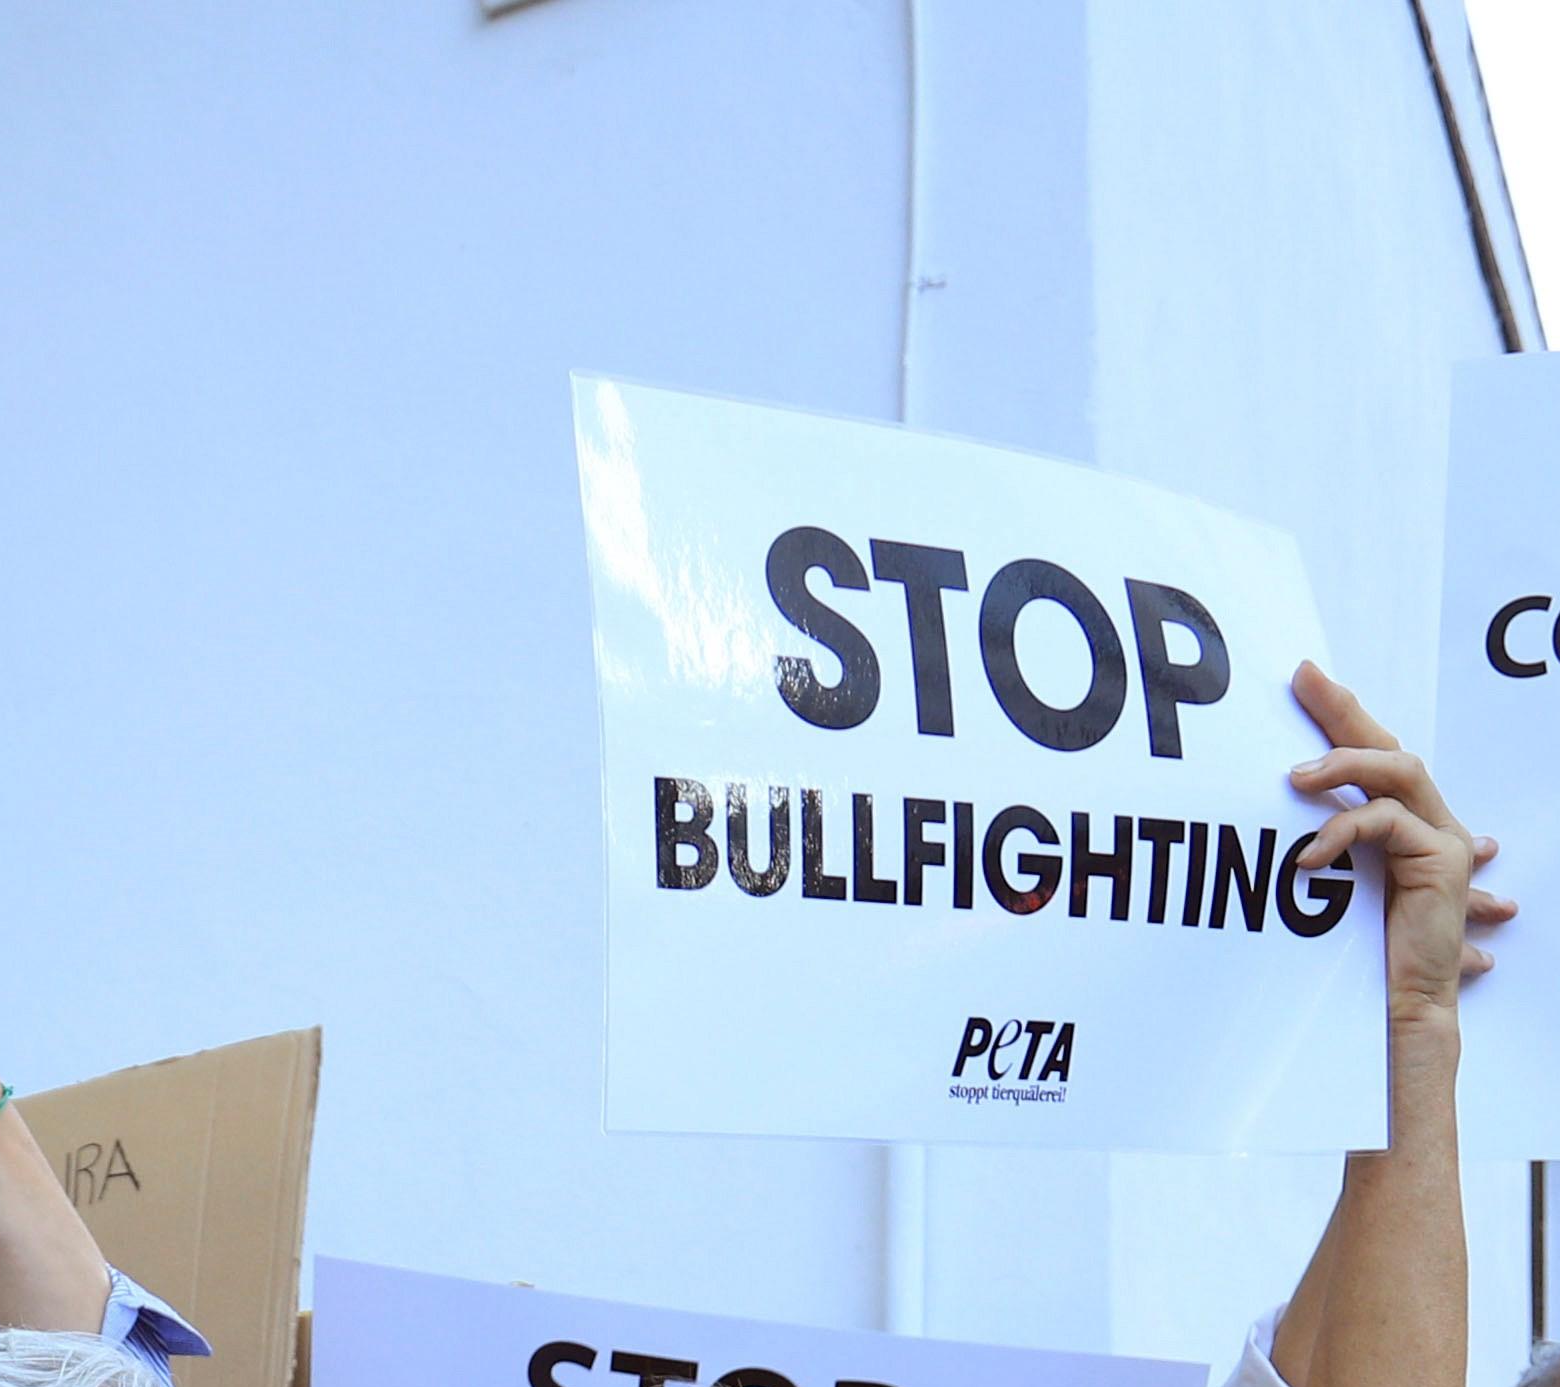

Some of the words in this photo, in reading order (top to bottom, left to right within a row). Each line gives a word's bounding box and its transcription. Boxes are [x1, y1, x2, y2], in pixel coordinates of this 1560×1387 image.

[765, 525, 1232, 759] STOP
[653, 776, 1355, 938] BULLFIGHTING
[948, 1084, 990, 1106] stoppt
[951, 1016, 1076, 1083] PeTA
